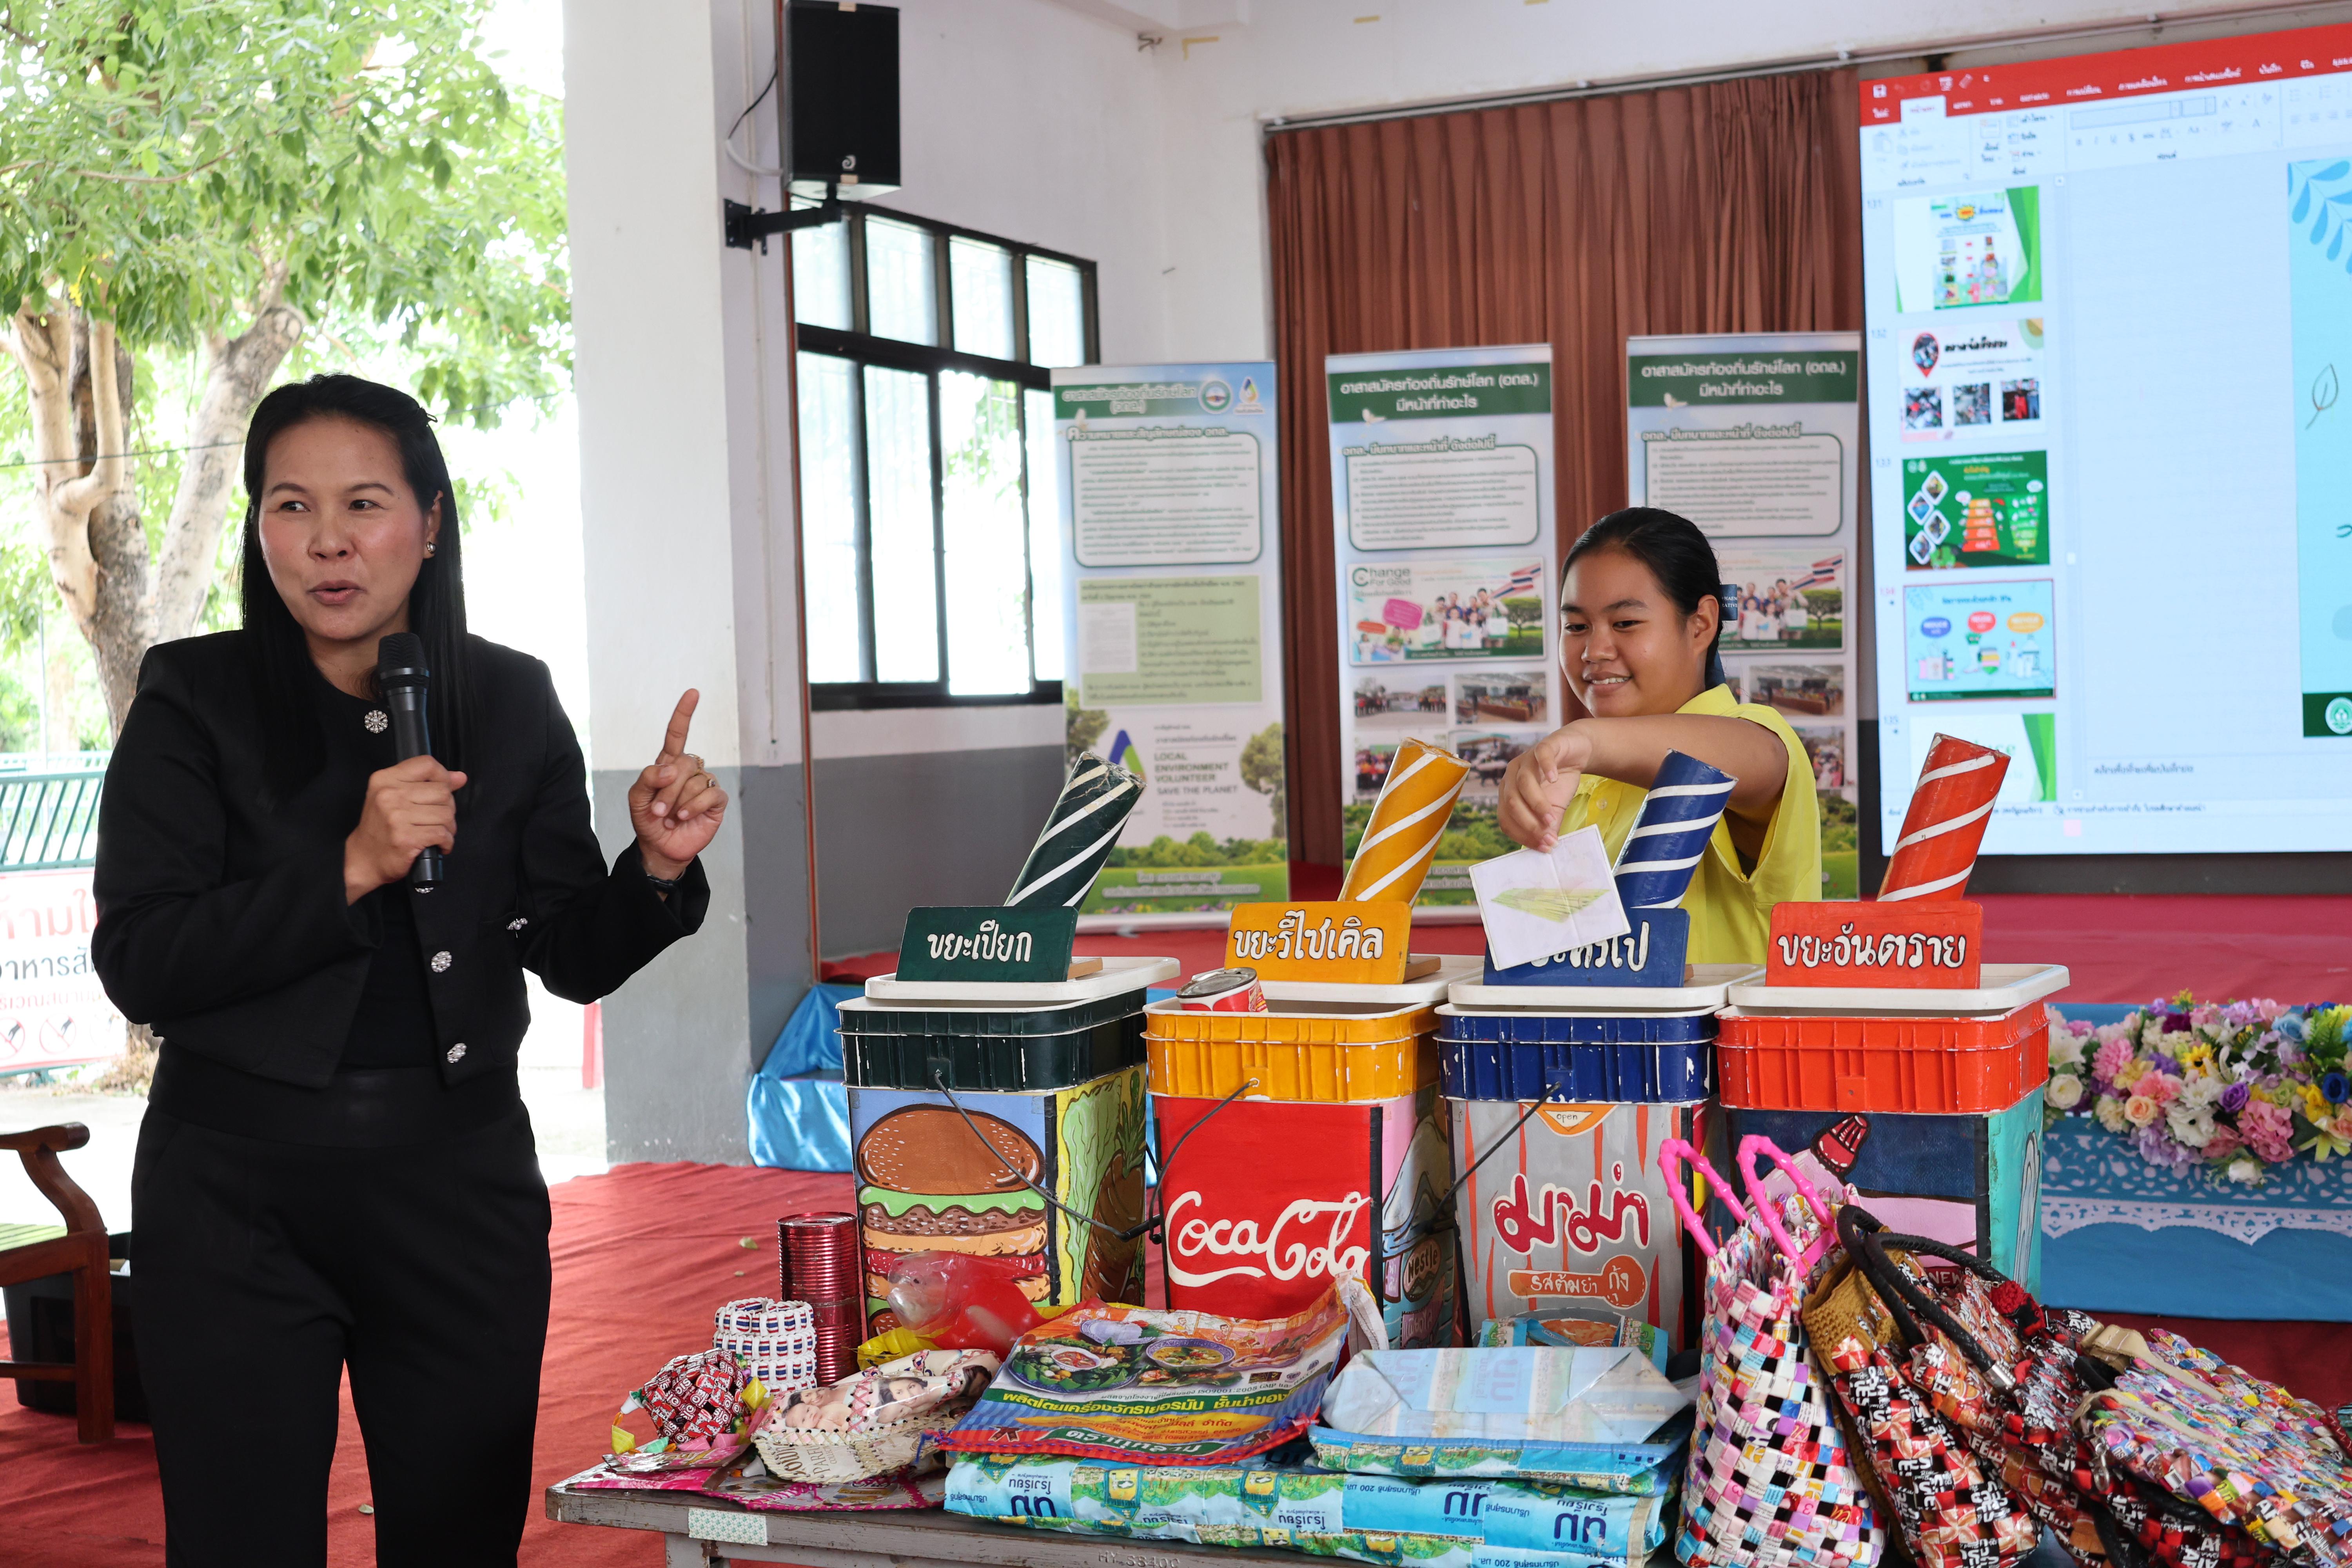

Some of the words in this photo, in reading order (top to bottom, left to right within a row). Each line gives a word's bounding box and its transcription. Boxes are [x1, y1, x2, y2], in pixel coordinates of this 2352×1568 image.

[1154, 752, 1187, 762] LOCAL
[1154, 762, 1229, 773] ENVIRONMENT
[927, 919, 1033, 962] ขยะเปียก
[1234, 909, 1384, 960] ขยะรีไซเคิล
[1778, 922, 1966, 968] ขยะอันตราย
[1009, 1479, 1051, 1495] โรงเรียน
[1378, 1486, 1421, 1496] ปริมาตรสุทธิ
[1279, 1514, 1325, 1530] โรงเรียน
[1553, 1513, 1606, 1544] นม
